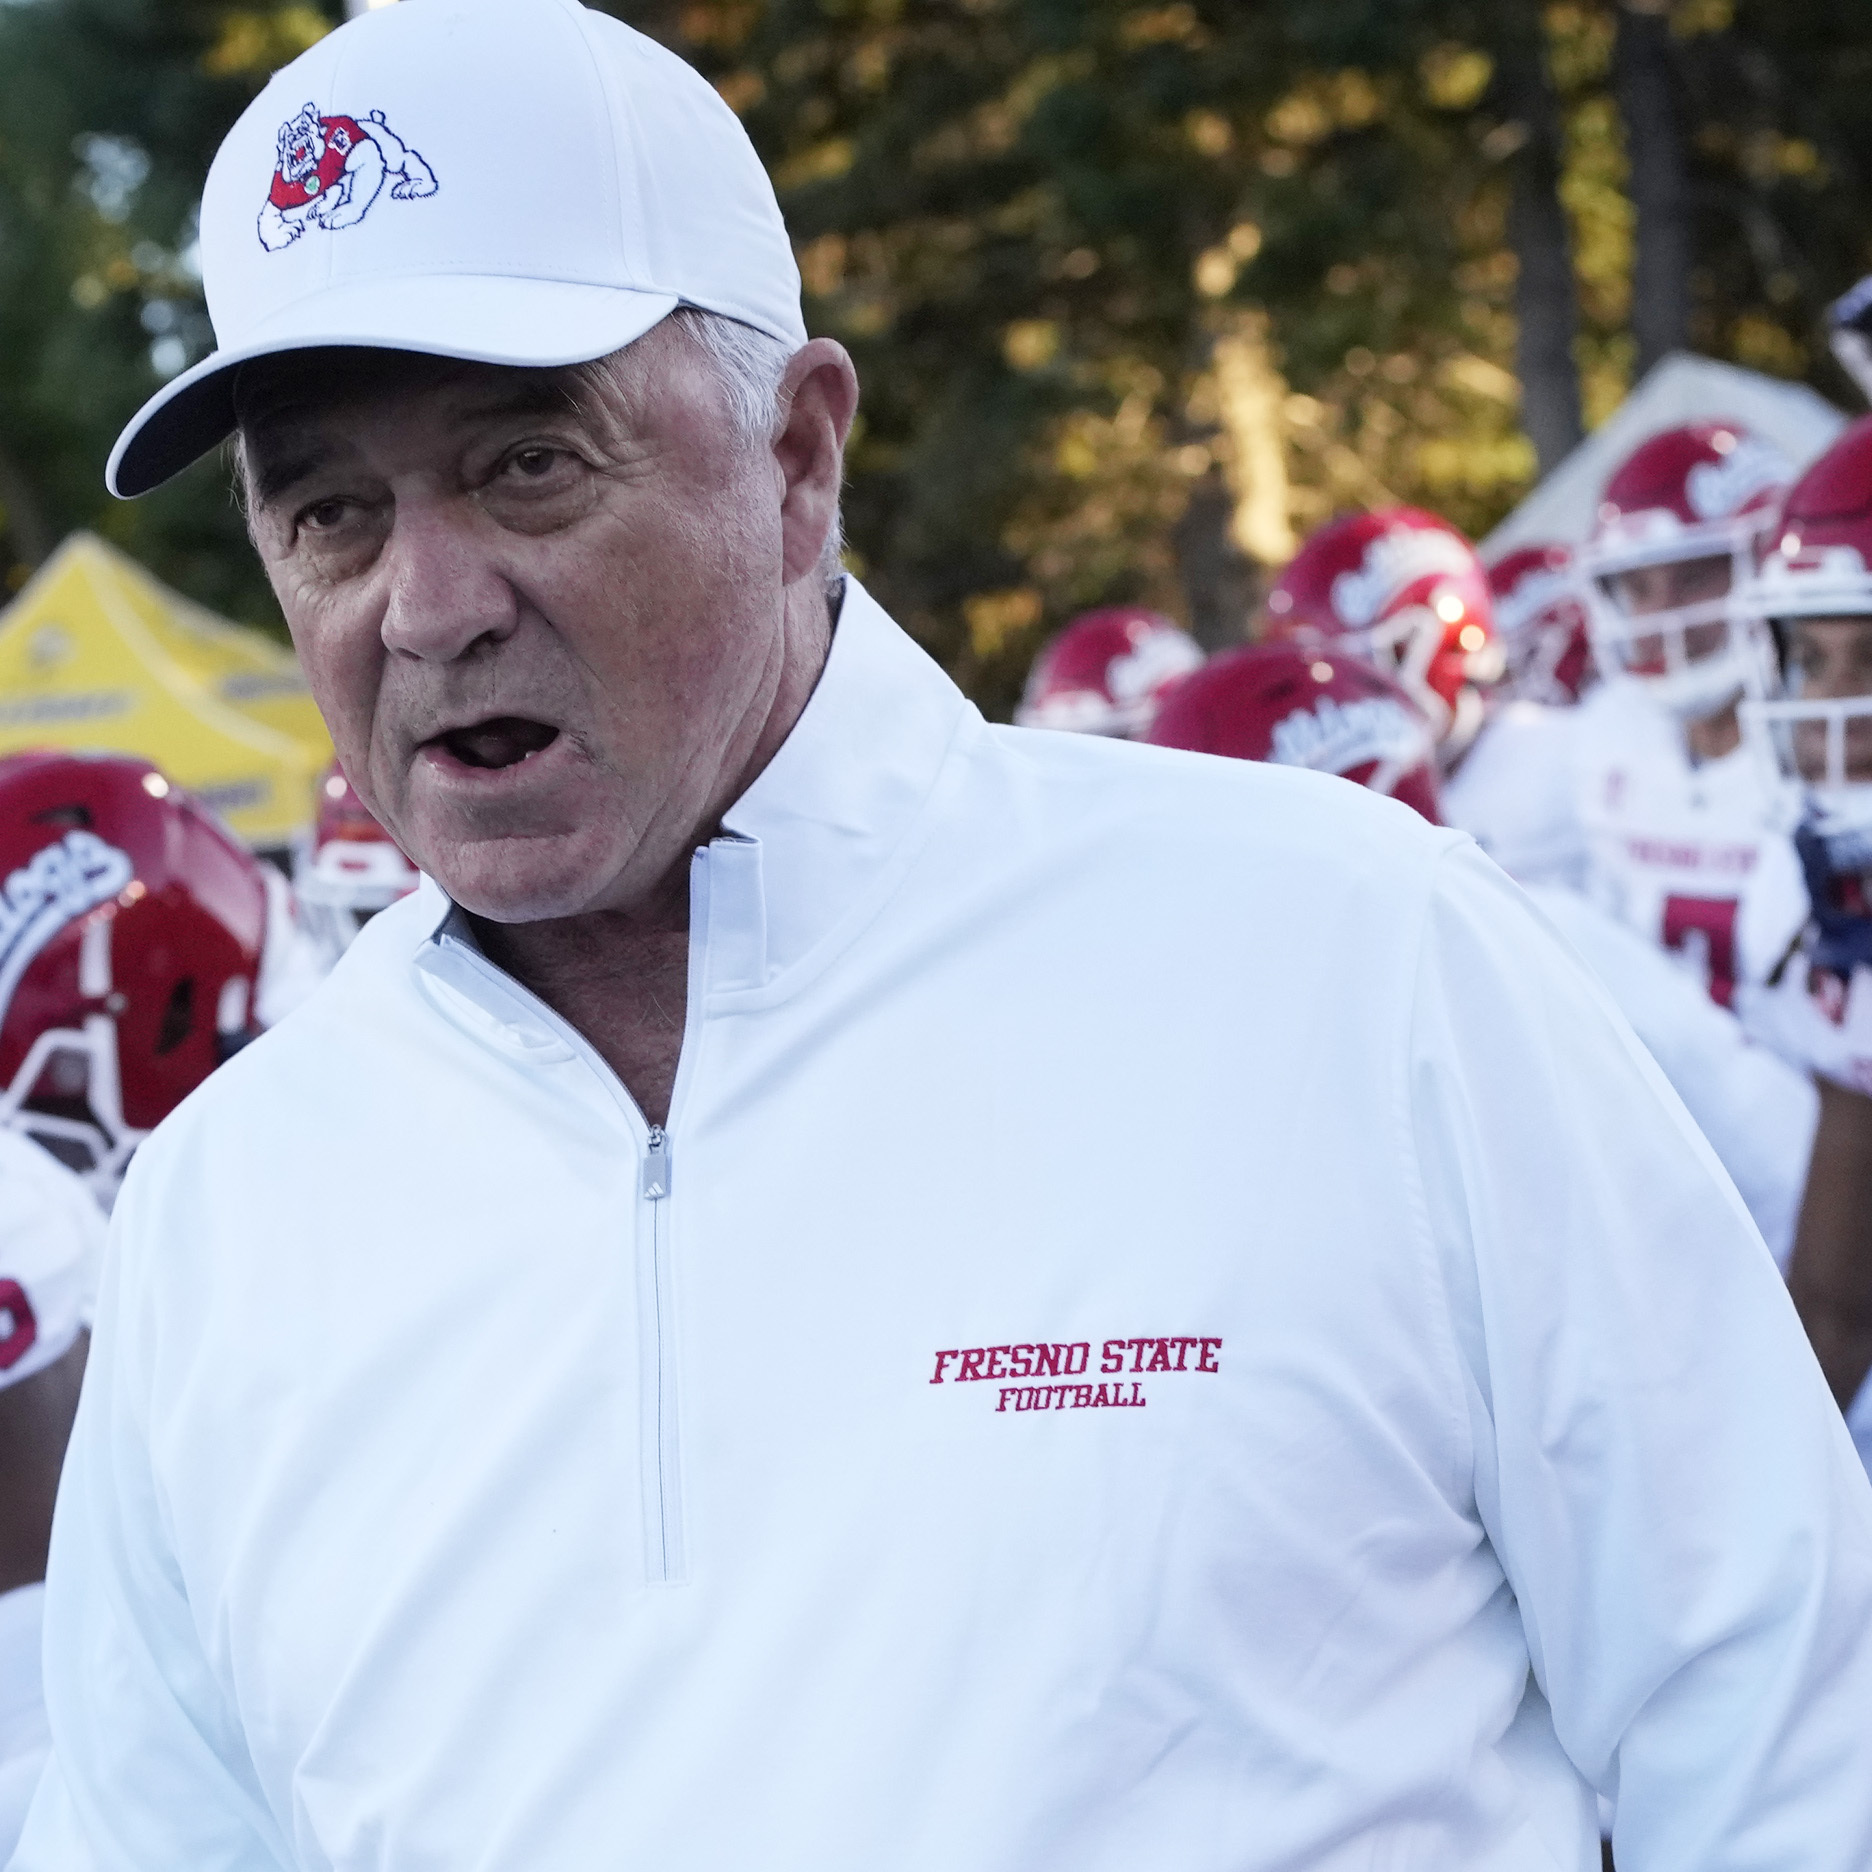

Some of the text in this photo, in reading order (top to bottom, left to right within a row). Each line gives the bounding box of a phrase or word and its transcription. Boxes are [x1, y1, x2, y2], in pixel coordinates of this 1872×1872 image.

[929, 1337, 1223, 1385] FRESNO STATE
[995, 1382, 1146, 1412] FOOTBALL
